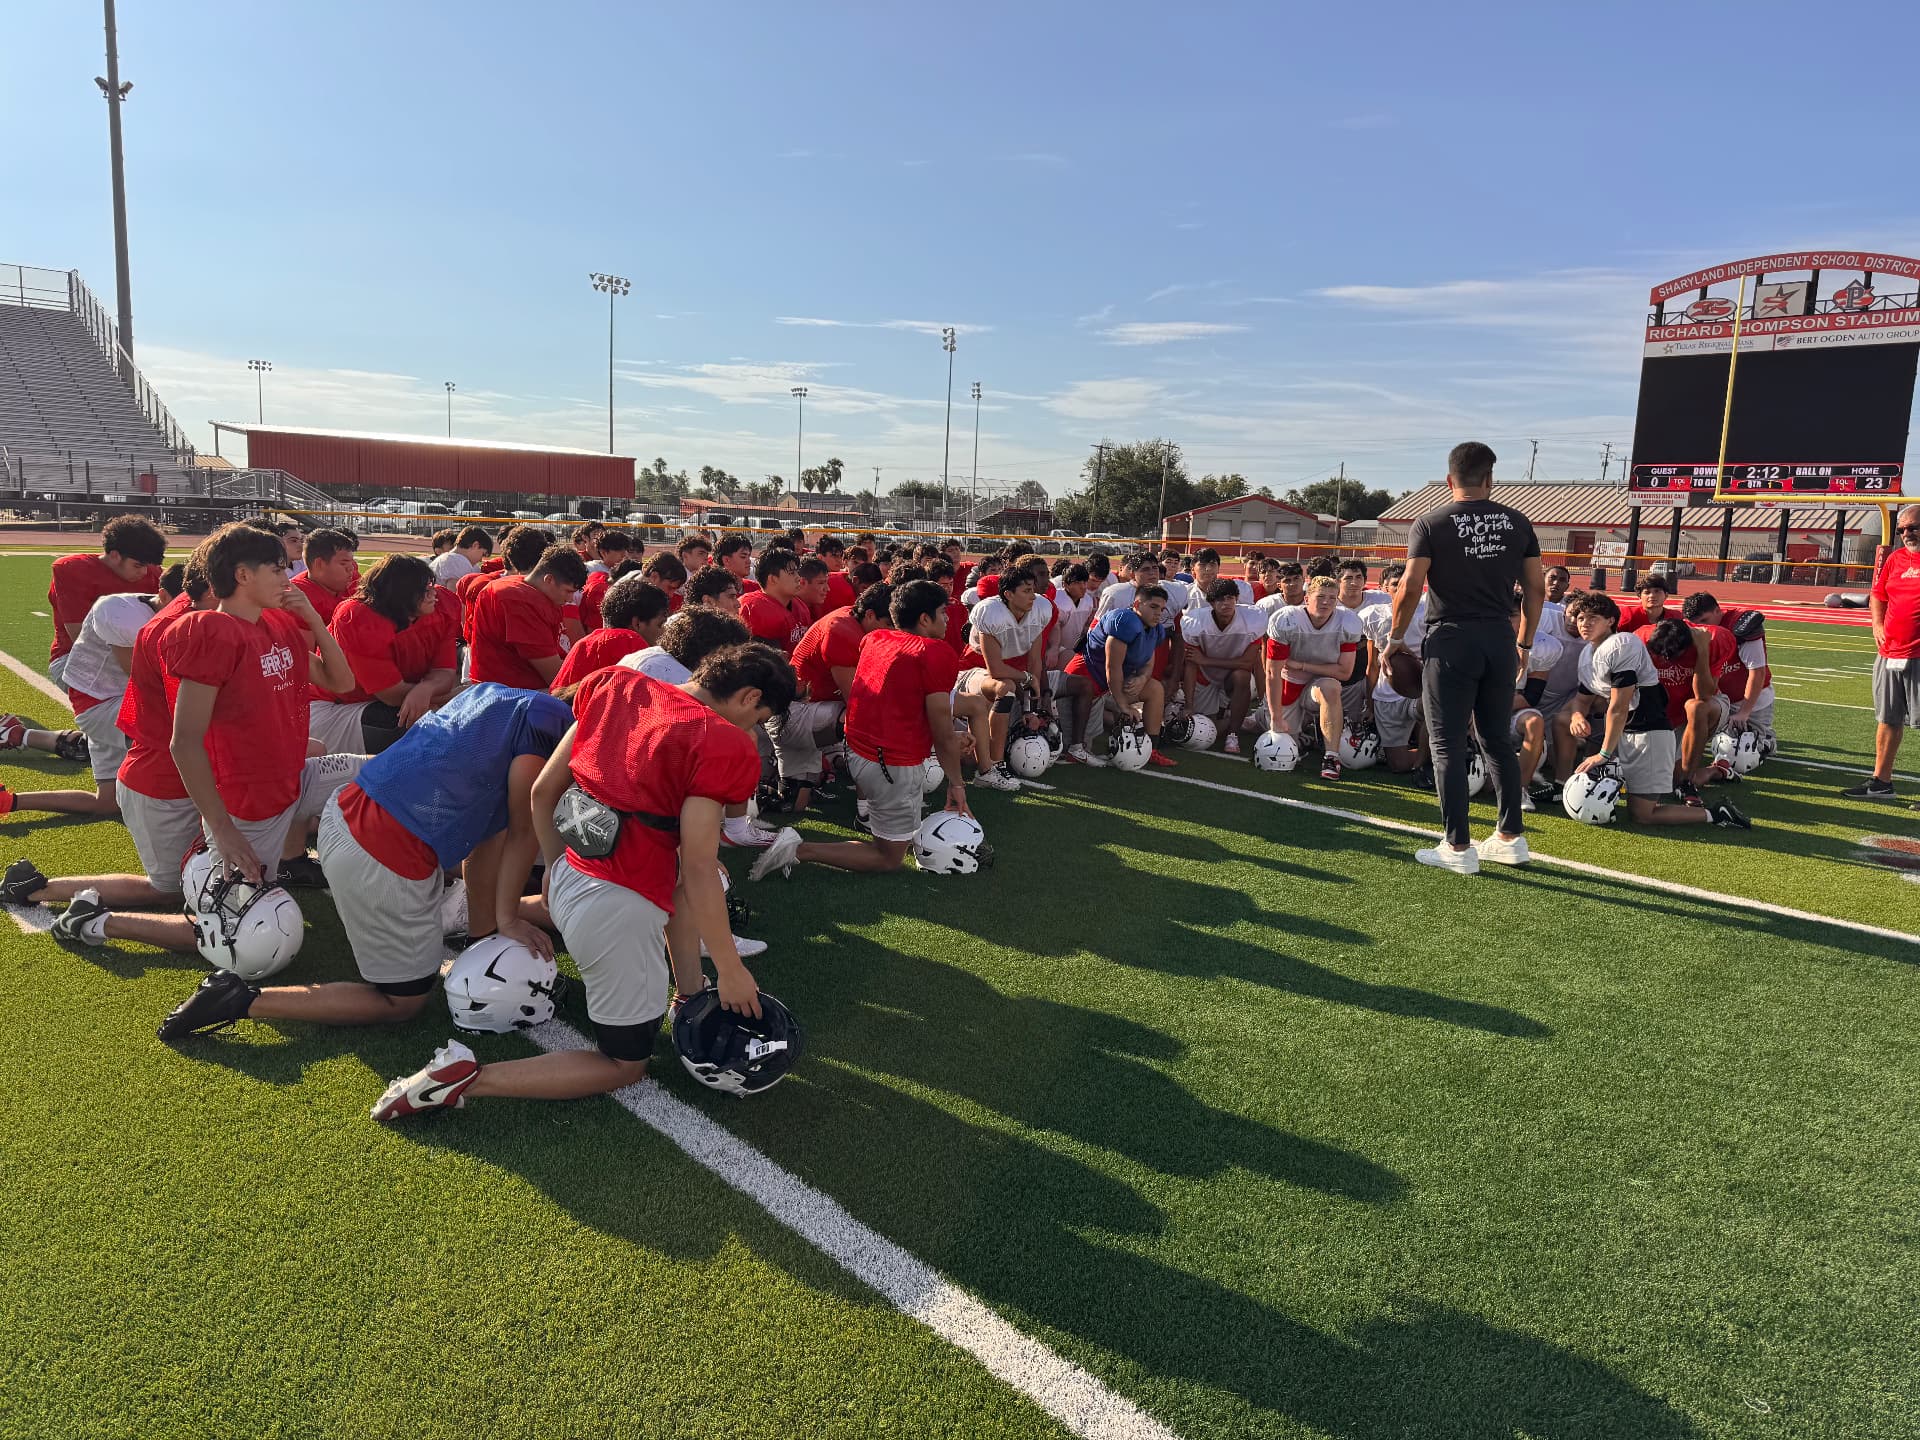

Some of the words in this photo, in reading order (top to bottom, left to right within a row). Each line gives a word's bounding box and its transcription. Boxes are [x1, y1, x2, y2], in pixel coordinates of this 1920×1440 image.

[1659, 268, 1725, 297] SHARYLAND
[1728, 255, 1809, 276] INDEPENDENT
[1811, 255, 1861, 266] SCHOOL
[1864, 257, 1920, 275] DISTRICT
[1649, 325, 1723, 340] RICHARD
[1729, 318, 1829, 334] THOMPSON
[1834, 311, 1920, 326] STADIUM
[1796, 336, 1819, 344] BERT
[1820, 333, 1855, 343] OGDEN
[1857, 331, 1884, 341] AUTO
[1886, 329, 1920, 339] GROUP
[1650, 467, 1678, 475] GUEST
[1693, 467, 1718, 475] DOWN
[1746, 466, 1780, 479] 2:12
[1795, 467, 1817, 475] BALL
[1819, 467, 1832, 475] ON
[1851, 467, 1880, 475] HOME
[1650, 477, 1658, 487] 0
[1693, 478, 1704, 486] TO
[1705, 478, 1716, 486] GO
[1747, 480, 1761, 488] QTR
[1864, 477, 1883, 488] 23
[1449, 514, 1471, 526] Todo
[1473, 513, 1481, 523] lo
[1484, 512, 1509, 523] puedo
[1474, 519, 1514, 535] Cristo
[1471, 535, 1485, 547] que
[1464, 542, 1506, 557] Fortalece
